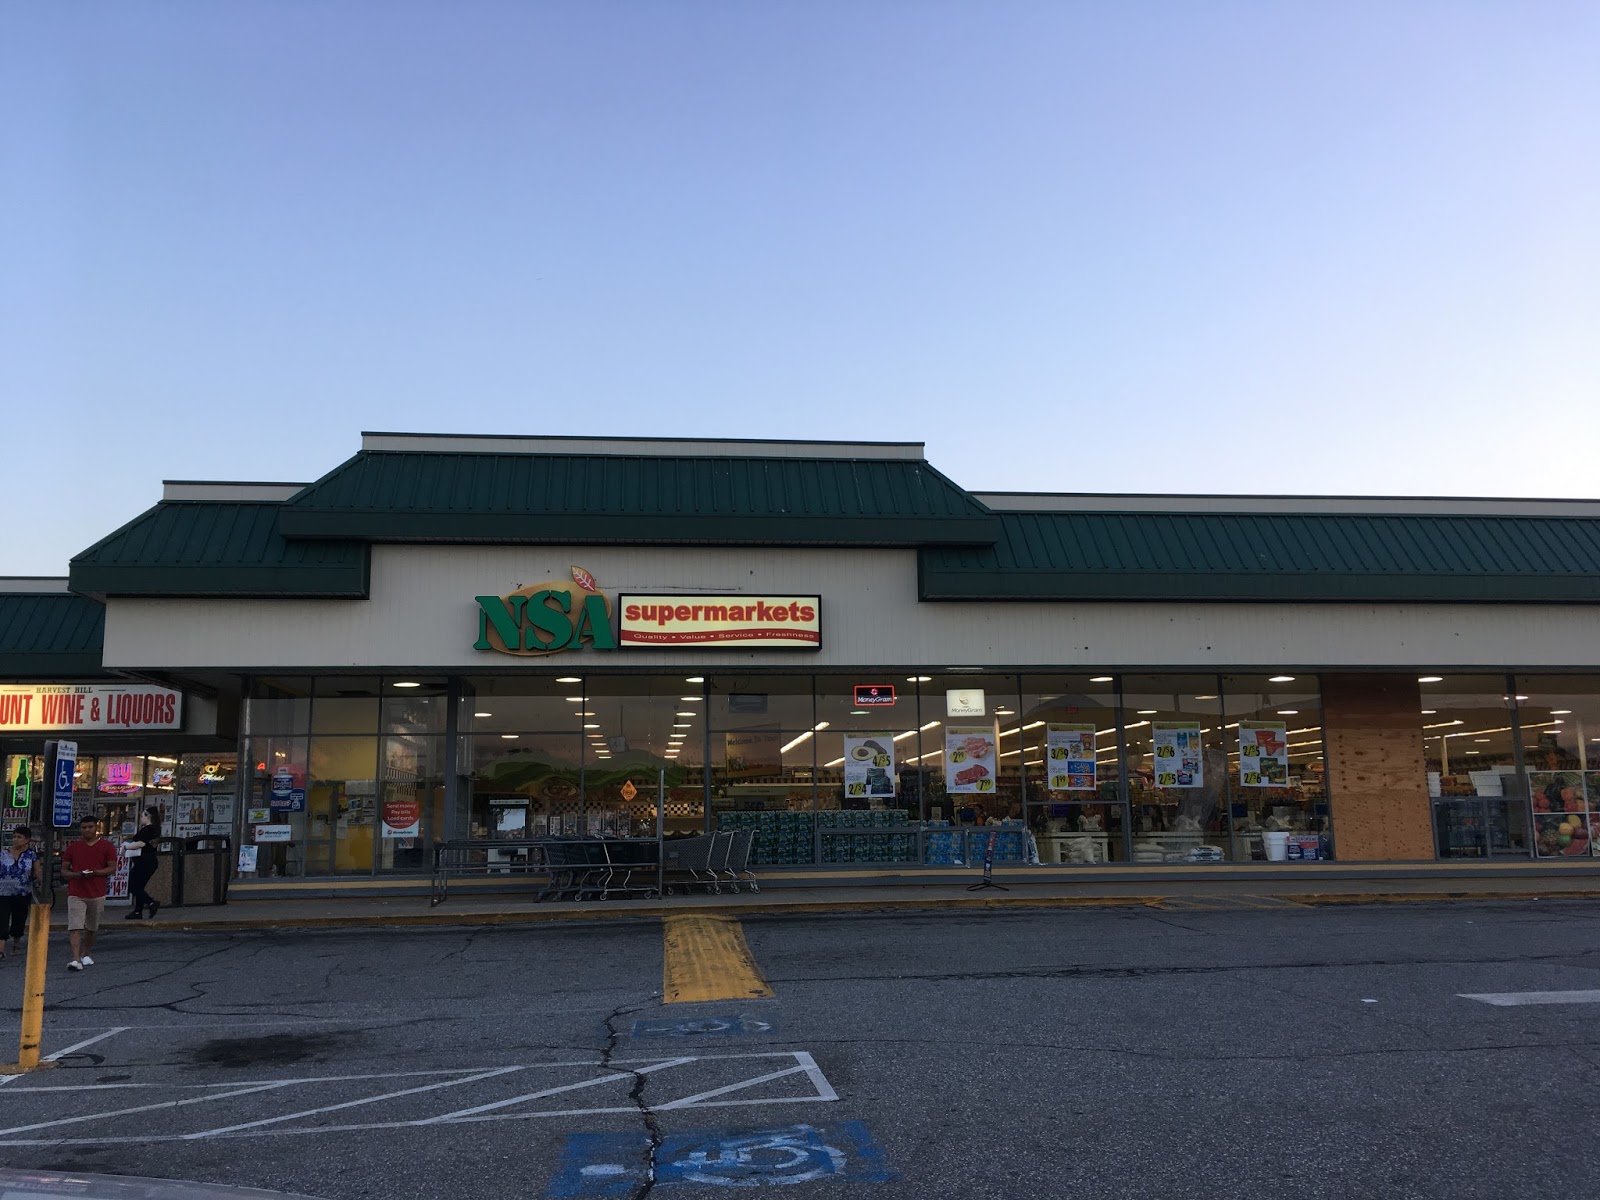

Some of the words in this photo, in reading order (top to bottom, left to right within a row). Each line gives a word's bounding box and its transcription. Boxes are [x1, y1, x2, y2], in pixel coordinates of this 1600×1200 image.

[625, 601, 815, 626] supermarkets
[473, 590, 618, 650] NSA
[766, 631, 815, 639] Freshness
[857, 696, 893, 704] MoneyGram
[42, 694, 85, 725] WINE
[90, 697, 100, 722] &
[107, 694, 176, 727] LIQUORS
[951, 707, 983, 715] MoneyGram
[4, 808, 26, 818] ATM
